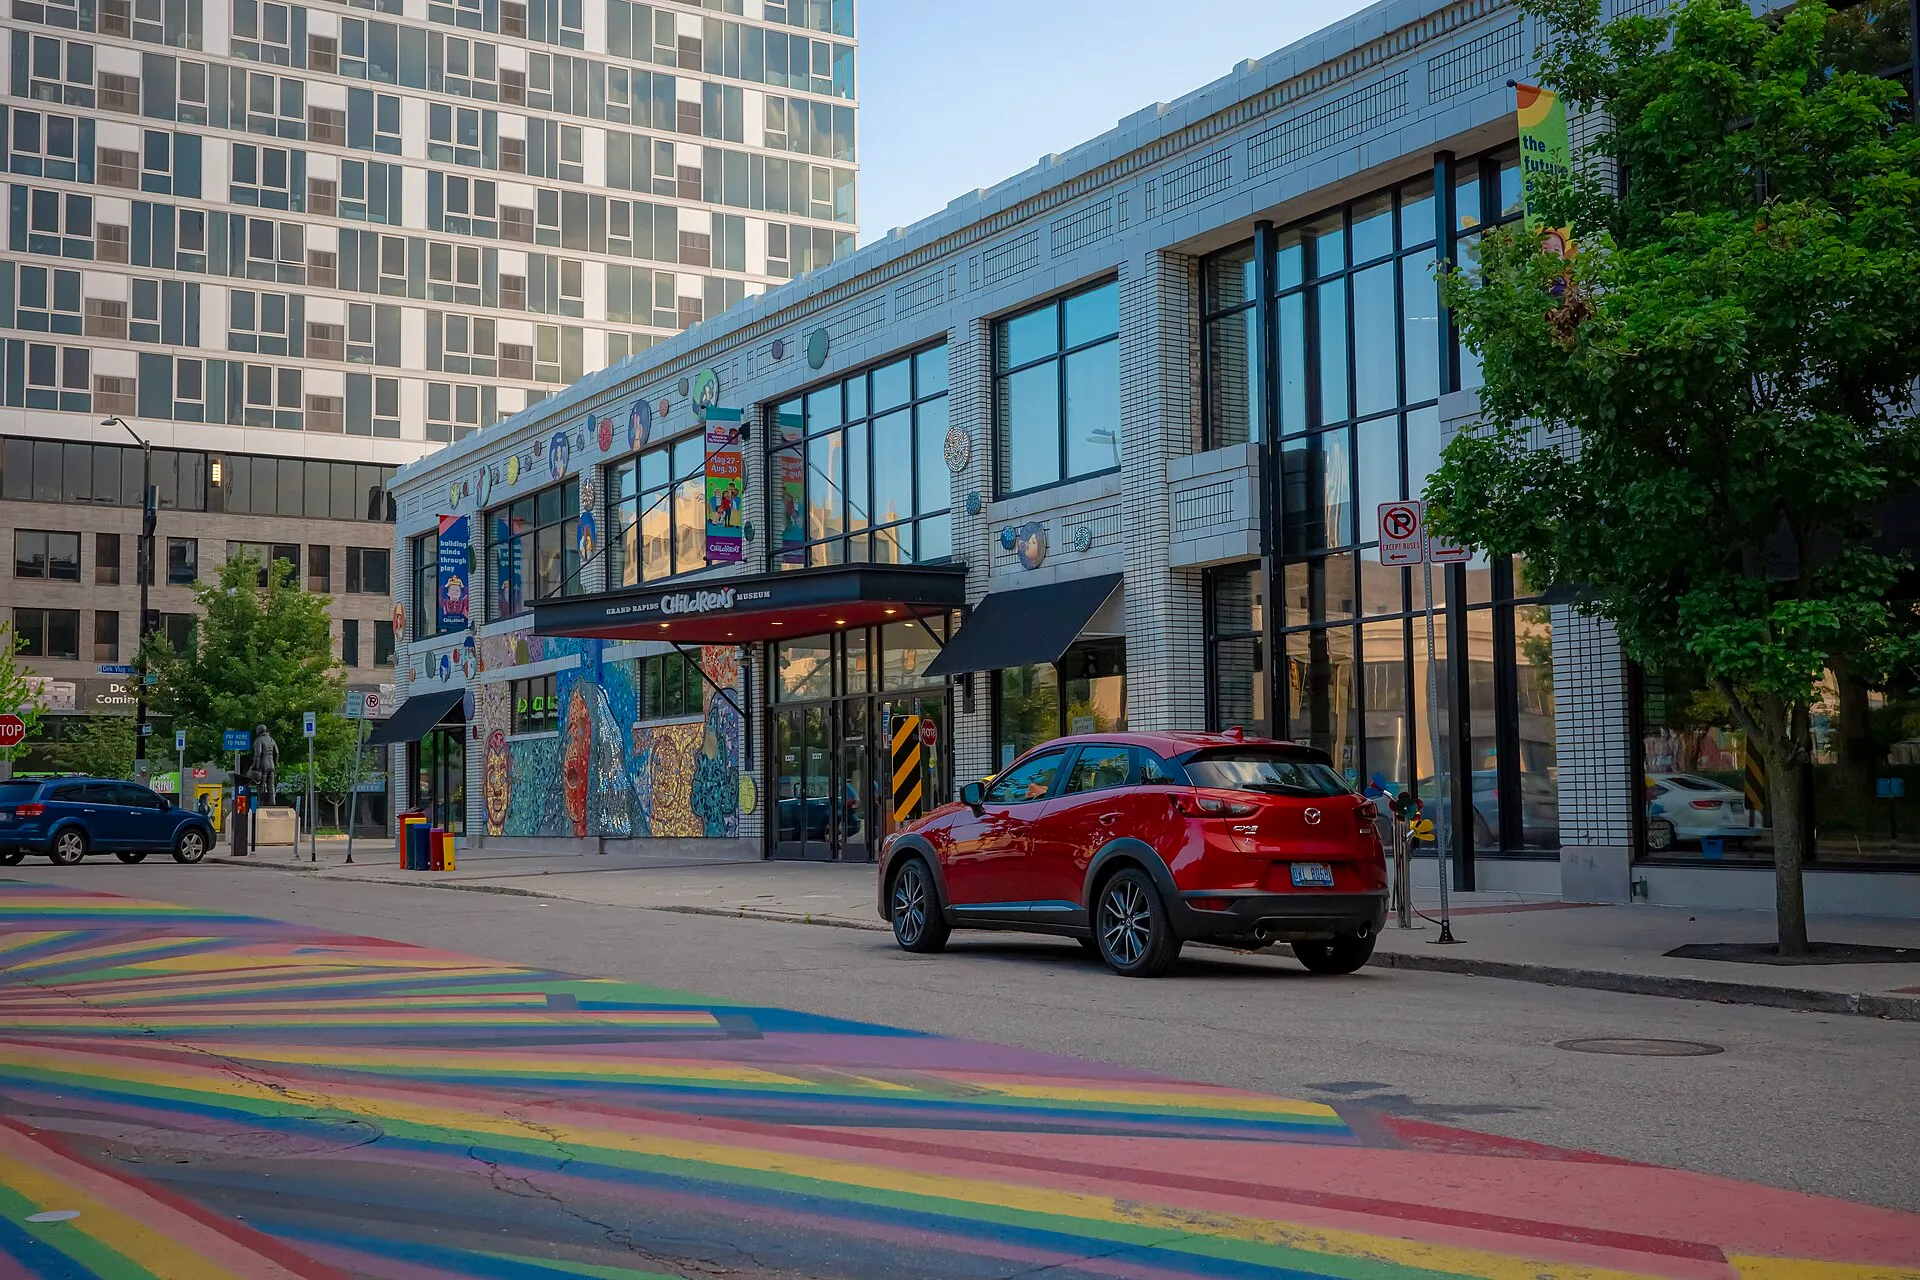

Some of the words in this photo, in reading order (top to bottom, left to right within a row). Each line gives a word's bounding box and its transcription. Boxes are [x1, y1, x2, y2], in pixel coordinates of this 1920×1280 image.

[1522, 135, 1546, 153] the
[727, 457, 735, 465] 27
[711, 465, 728, 474] Aug.
[729, 466, 738, 474] 30
[441, 540, 467, 549] building
[1403, 541, 1420, 550] BUSES
[441, 557, 466, 565] through
[441, 565, 454, 573] play
[606, 607, 631, 615] GRAND
[632, 602, 659, 613] RAPIDS
[736, 591, 771, 600] MUSEUM
[115, 665, 126, 673] Vlug
[0, 724, 22, 736] TOP
